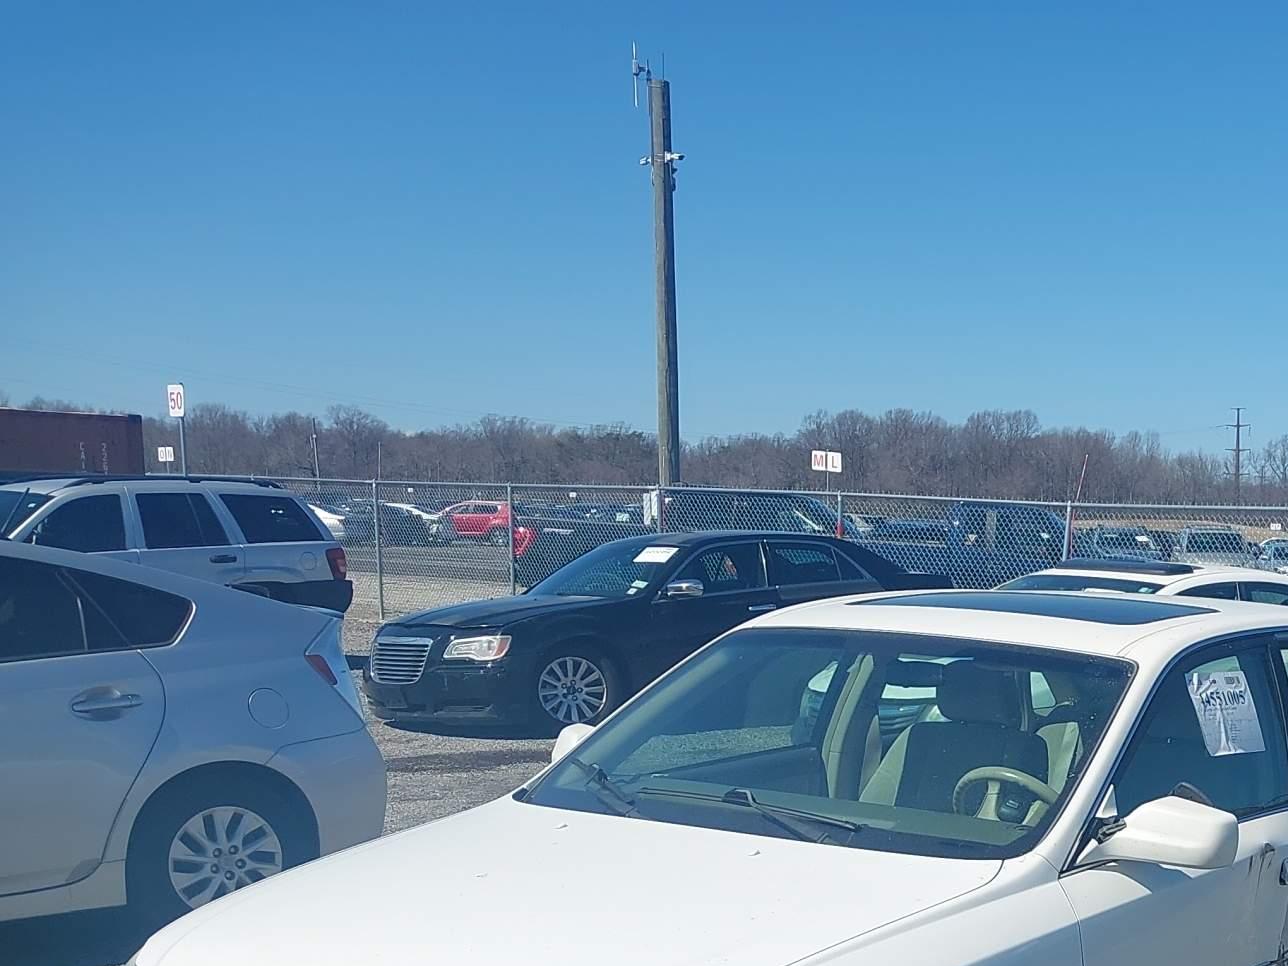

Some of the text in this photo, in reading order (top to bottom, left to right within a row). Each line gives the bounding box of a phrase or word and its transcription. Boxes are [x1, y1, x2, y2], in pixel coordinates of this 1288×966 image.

[169, 391, 182, 410] 50
[813, 454, 838, 469] M L
